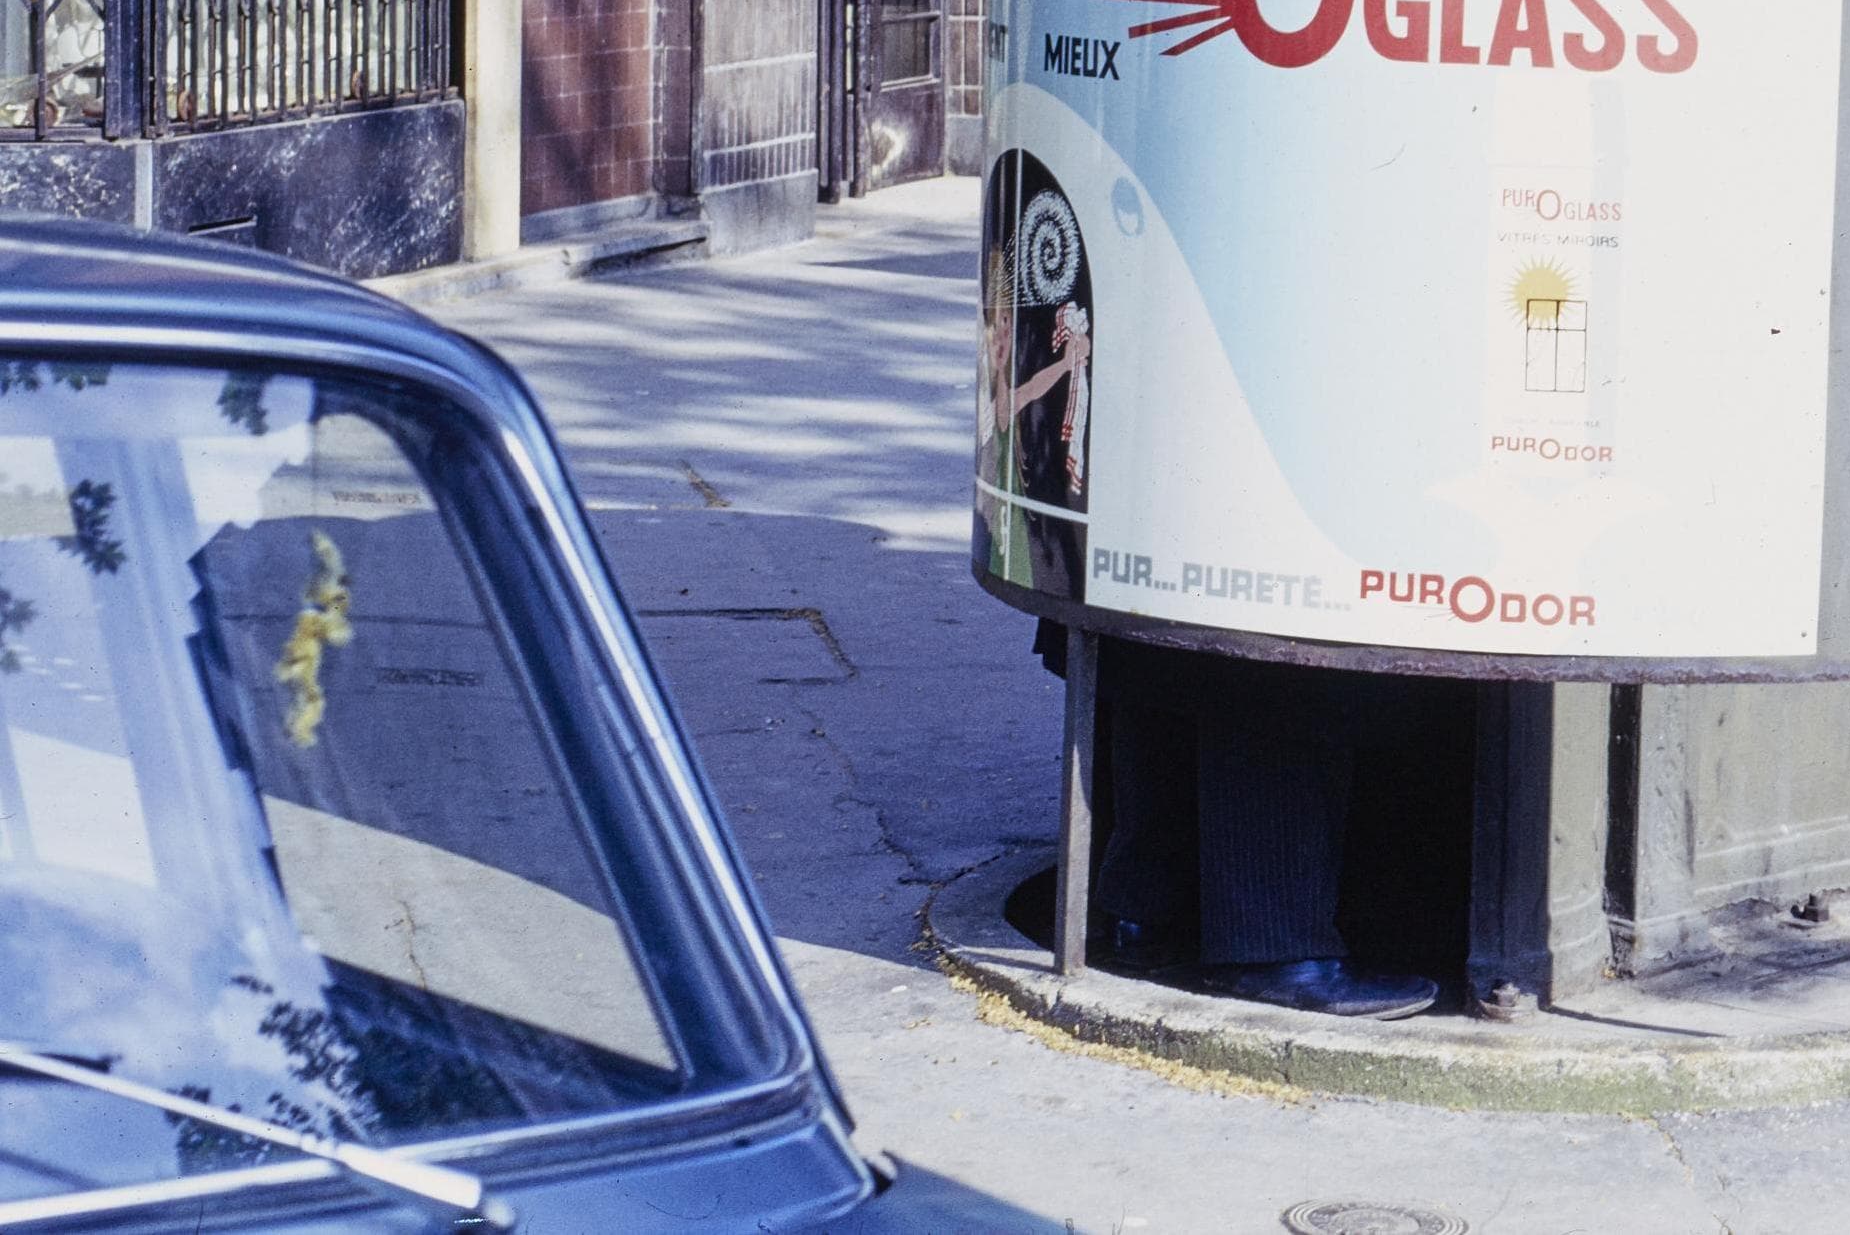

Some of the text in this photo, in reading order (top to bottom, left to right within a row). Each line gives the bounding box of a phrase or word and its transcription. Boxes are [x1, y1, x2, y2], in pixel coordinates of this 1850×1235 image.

[1044, 33, 1121, 80] MIEUX
[1501, 188, 1622, 222] PUROGLASS
[1491, 435, 1613, 462] PURODOR
[1359, 569, 1596, 623] PURODOR
